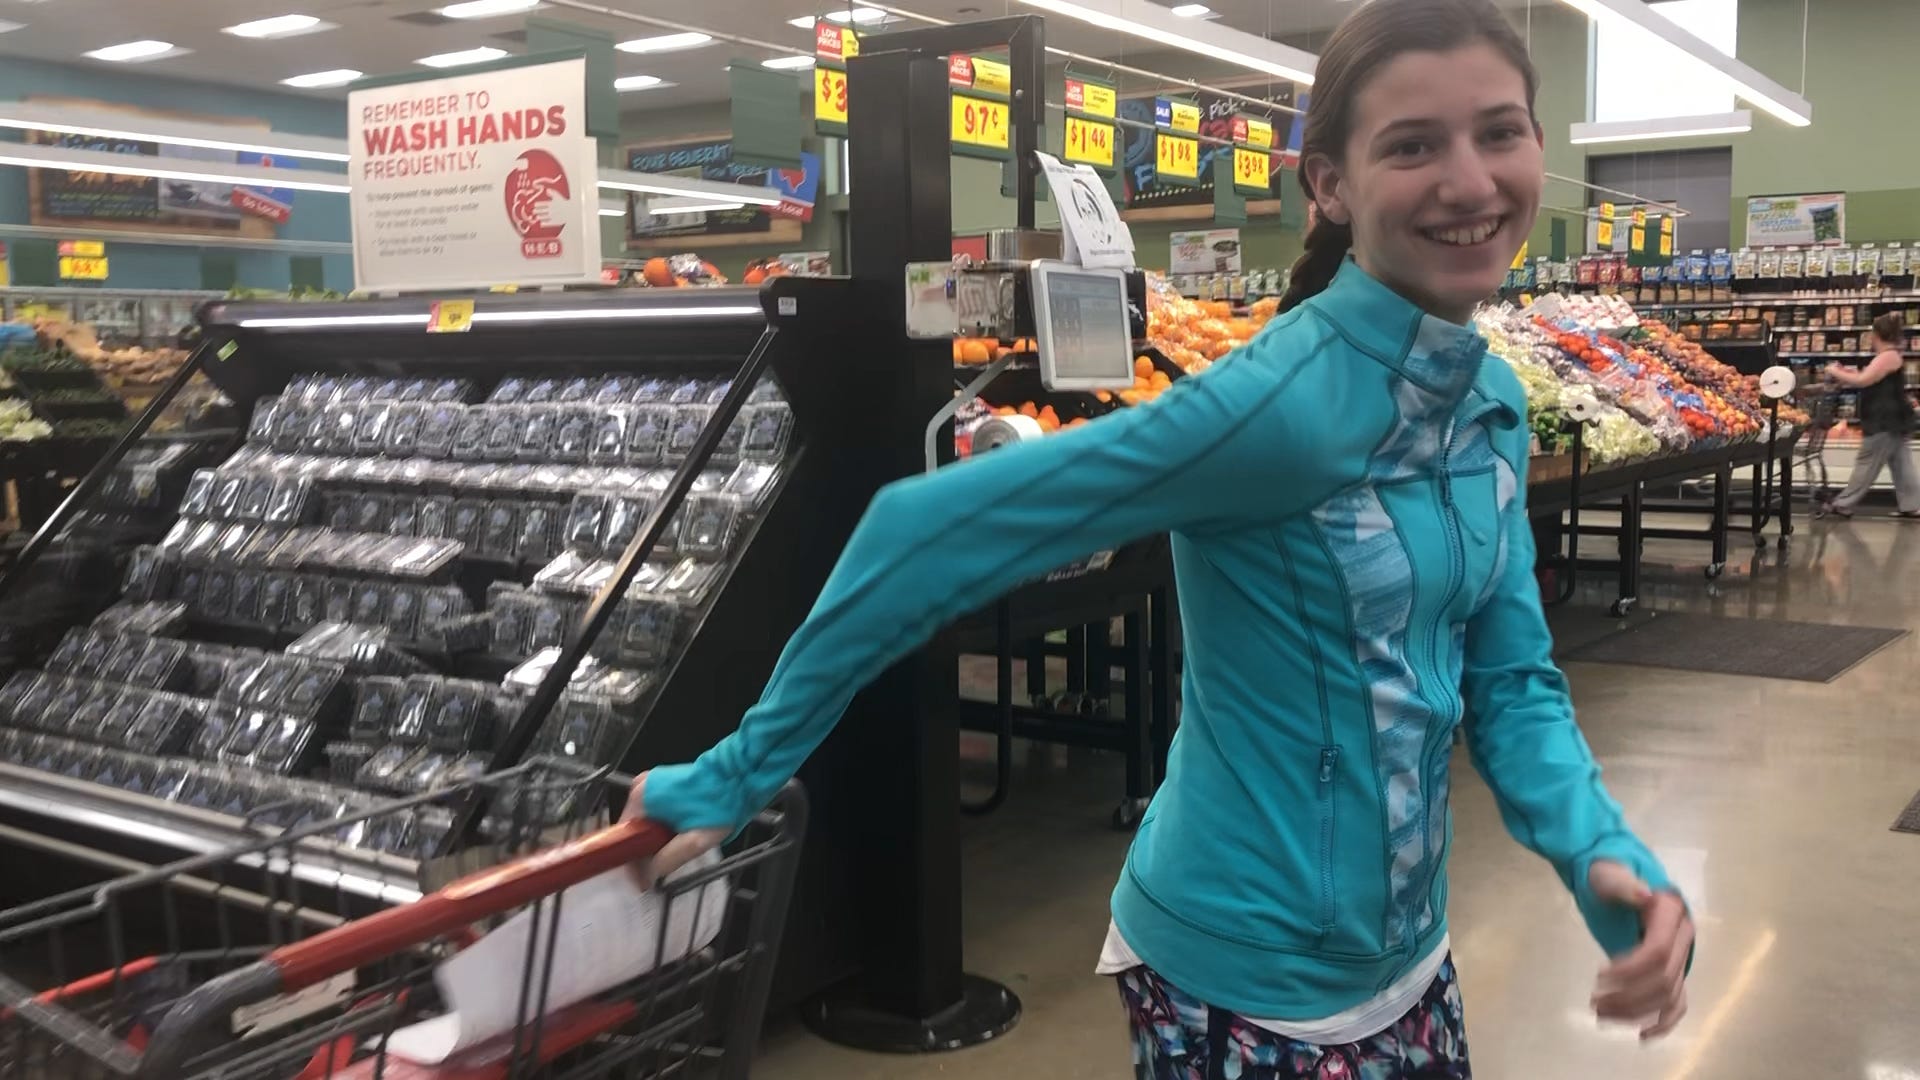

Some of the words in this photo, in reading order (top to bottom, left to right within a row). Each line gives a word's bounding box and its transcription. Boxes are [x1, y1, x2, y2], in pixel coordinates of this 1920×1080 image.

[821, 26, 838, 39] LOW
[817, 34, 842, 50] PRICES
[953, 56, 968, 69] LOW
[951, 64, 971, 78] PRICES
[362, 94, 460, 124] REMEMBER
[466, 90, 491, 110] TO
[362, 119, 448, 156] WASH
[456, 104, 567, 147] HANDS
[363, 150, 482, 181] FREQUENTLY.
